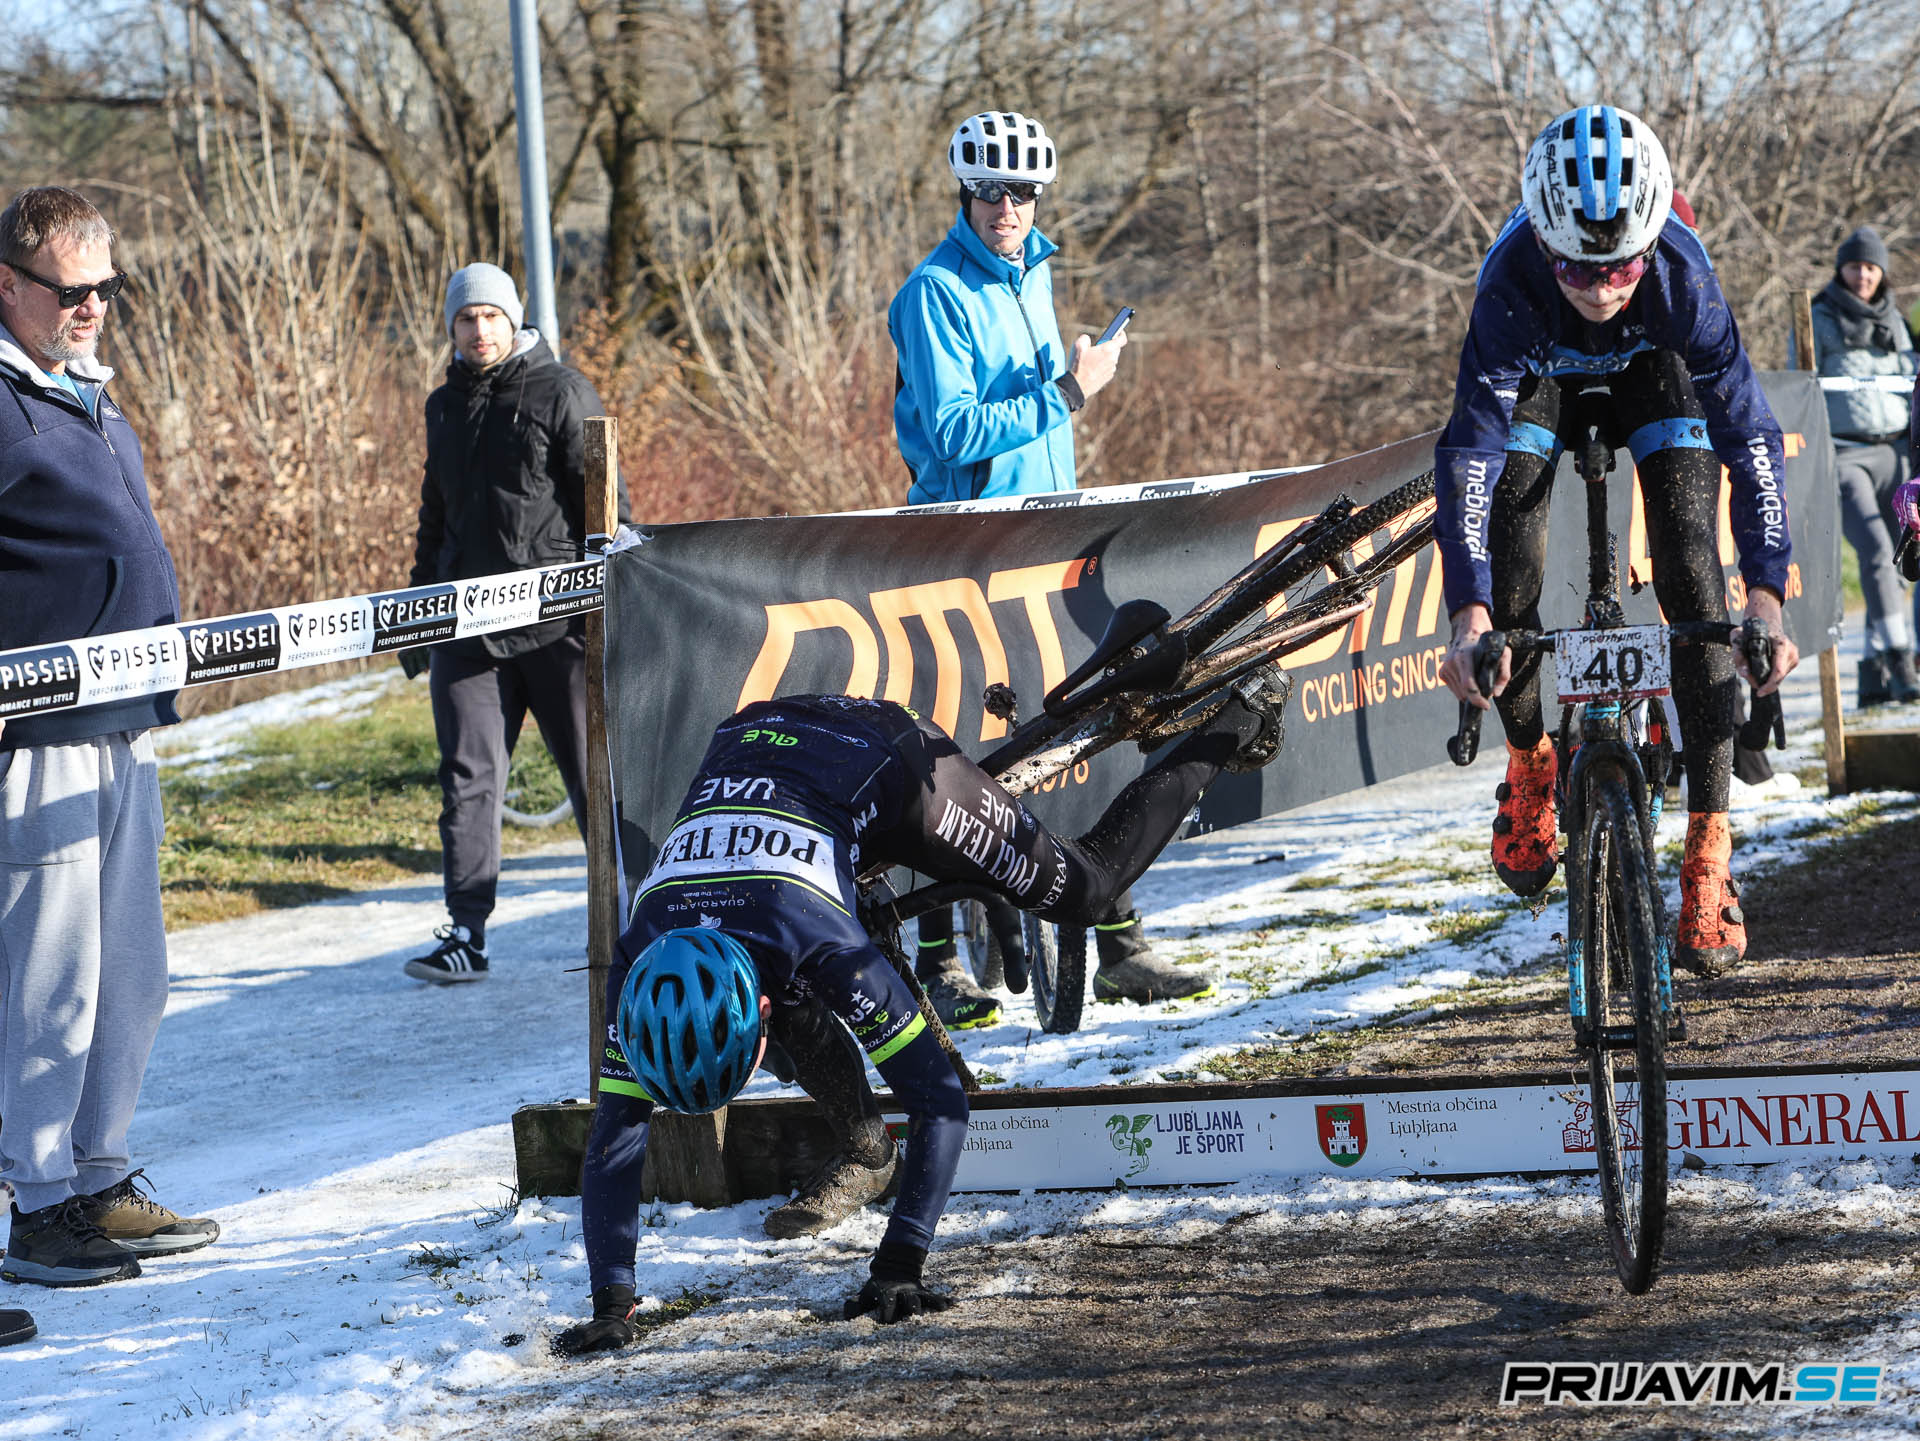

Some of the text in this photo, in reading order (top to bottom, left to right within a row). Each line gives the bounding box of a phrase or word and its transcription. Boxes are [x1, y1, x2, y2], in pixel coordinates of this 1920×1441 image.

[559, 565, 604, 593] PISSE
[481, 580, 534, 608] PISSEI
[542, 600, 580, 614] PERFORMANCE
[580, 596, 594, 606] WITH
[308, 609, 366, 638] PISSEI
[396, 594, 454, 624] PISSEI
[211, 623, 276, 656] PISSEI
[377, 626, 452, 647] PERFORMANCE WITH STYLE
[735, 557, 1088, 742] DMT
[110, 639, 178, 672] PISSEI
[190, 657, 276, 680] PERFORMANCE WITH STYLE
[1582, 646, 1643, 688] 40
[0, 655, 76, 690] PISSEI
[1301, 645, 1447, 723] CYCLING SINCE
[32, 695, 52, 707] WITH
[52, 691, 74, 704] STYLE
[692, 776, 776, 806] UAE
[980, 787, 1016, 839] UAE
[656, 826, 714, 869] TEA
[725, 824, 820, 867] POGI
[935, 798, 995, 869] TEAM
[987, 838, 1040, 897] POGI
[863, 1010, 912, 1050] COLNAGO
[600, 1065, 633, 1078] COLNA
[1387, 1096, 1498, 1114] Mestna občina
[968, 1115, 1050, 1132] stna občina
[1155, 1109, 1244, 1133] LJUBLJANA
[1389, 1119, 1458, 1138] Ljubljana
[962, 1136, 1013, 1155] ubljana
[1175, 1130, 1246, 1155] JE ŠPORT
